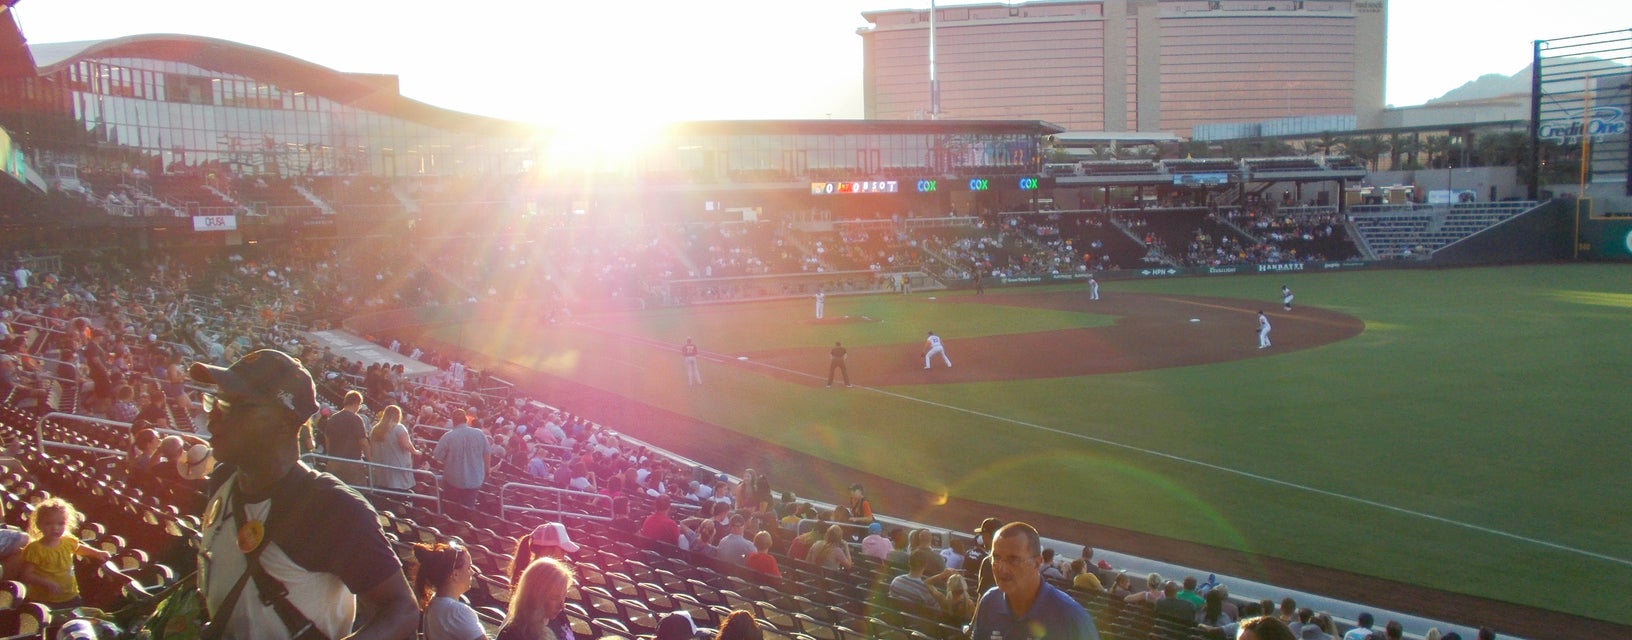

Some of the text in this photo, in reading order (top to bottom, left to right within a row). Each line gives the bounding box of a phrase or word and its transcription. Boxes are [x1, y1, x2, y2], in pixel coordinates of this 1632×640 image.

[1588, 119, 1626, 135] One
[917, 180, 937, 192] COX
[969, 179, 989, 191] COX
[1019, 178, 1038, 190] COX
